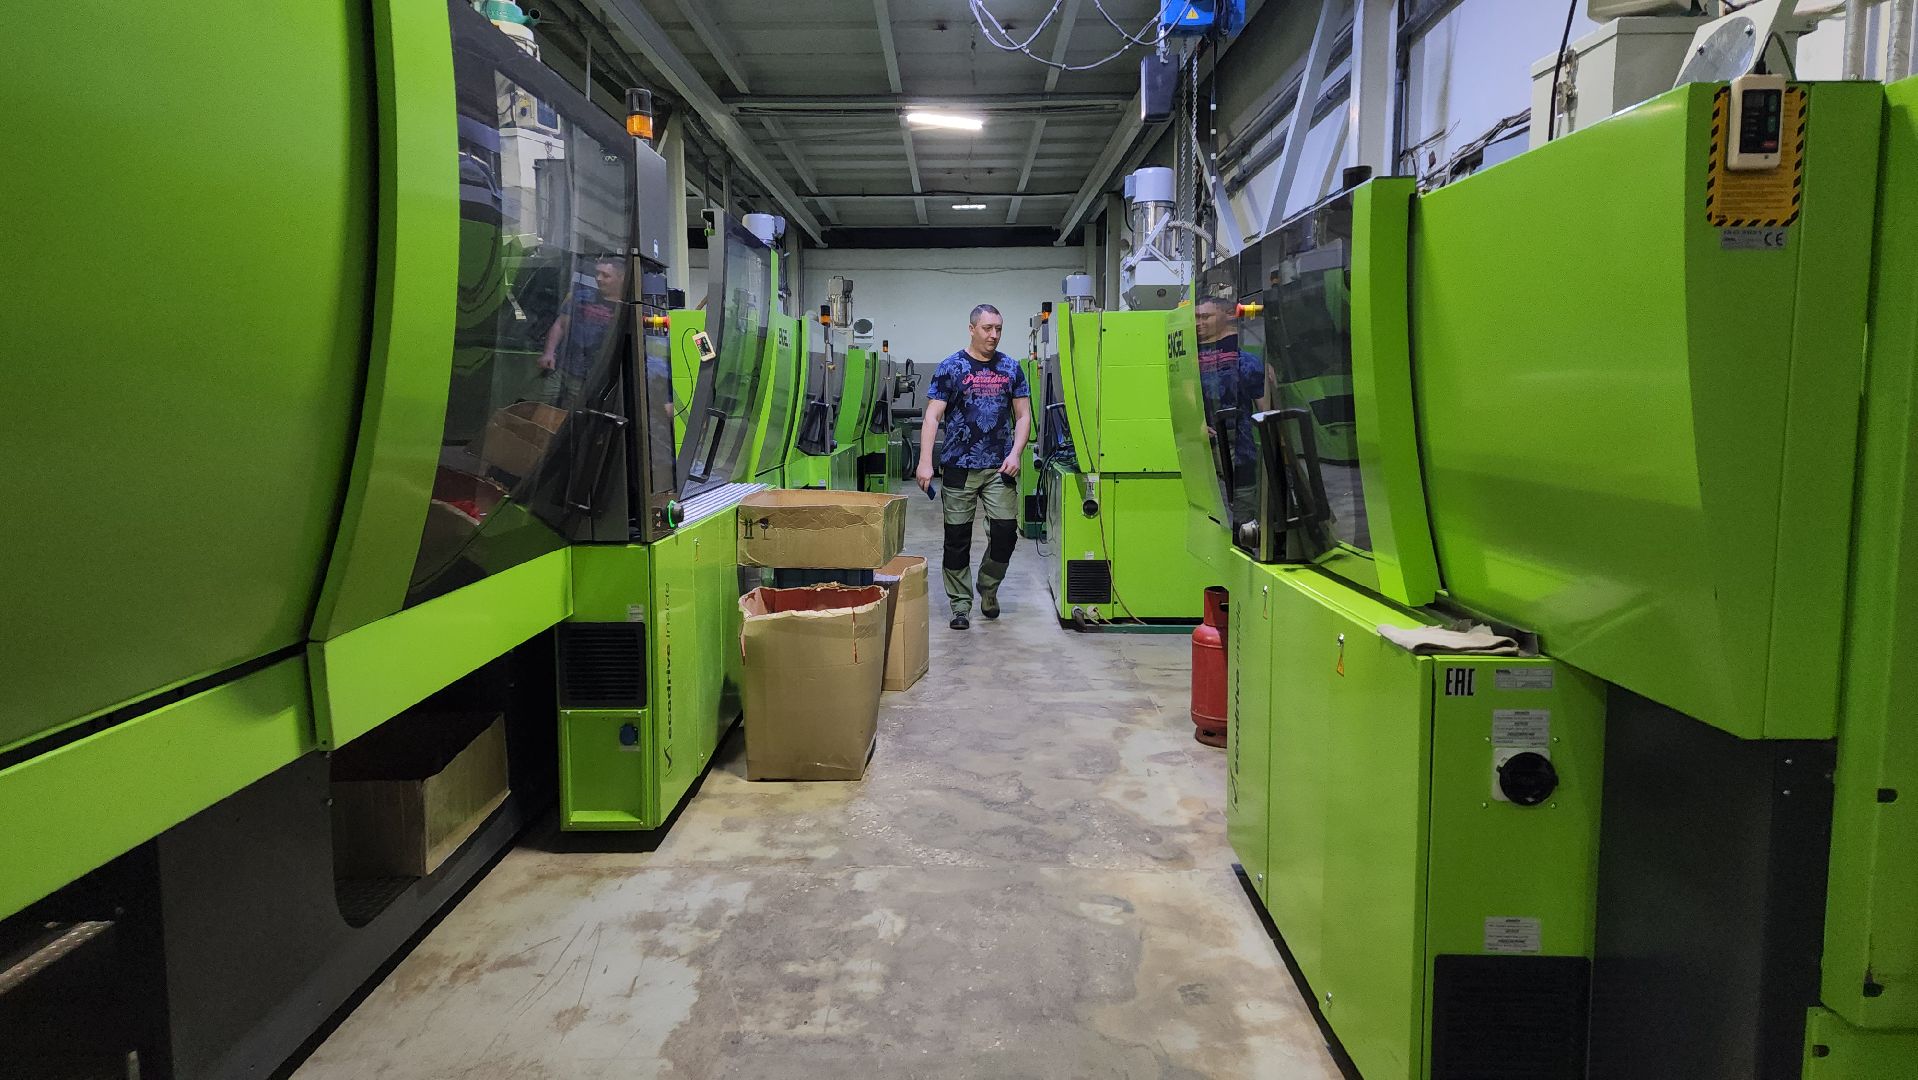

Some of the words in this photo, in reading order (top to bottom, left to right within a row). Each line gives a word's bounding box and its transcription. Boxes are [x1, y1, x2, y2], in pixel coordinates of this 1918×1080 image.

[1168, 329, 1187, 359] ENGEL
[665, 643, 673, 741] ecodrive
[1444, 667, 1476, 696] EAC
[1233, 668, 1241, 776] ecodrive
